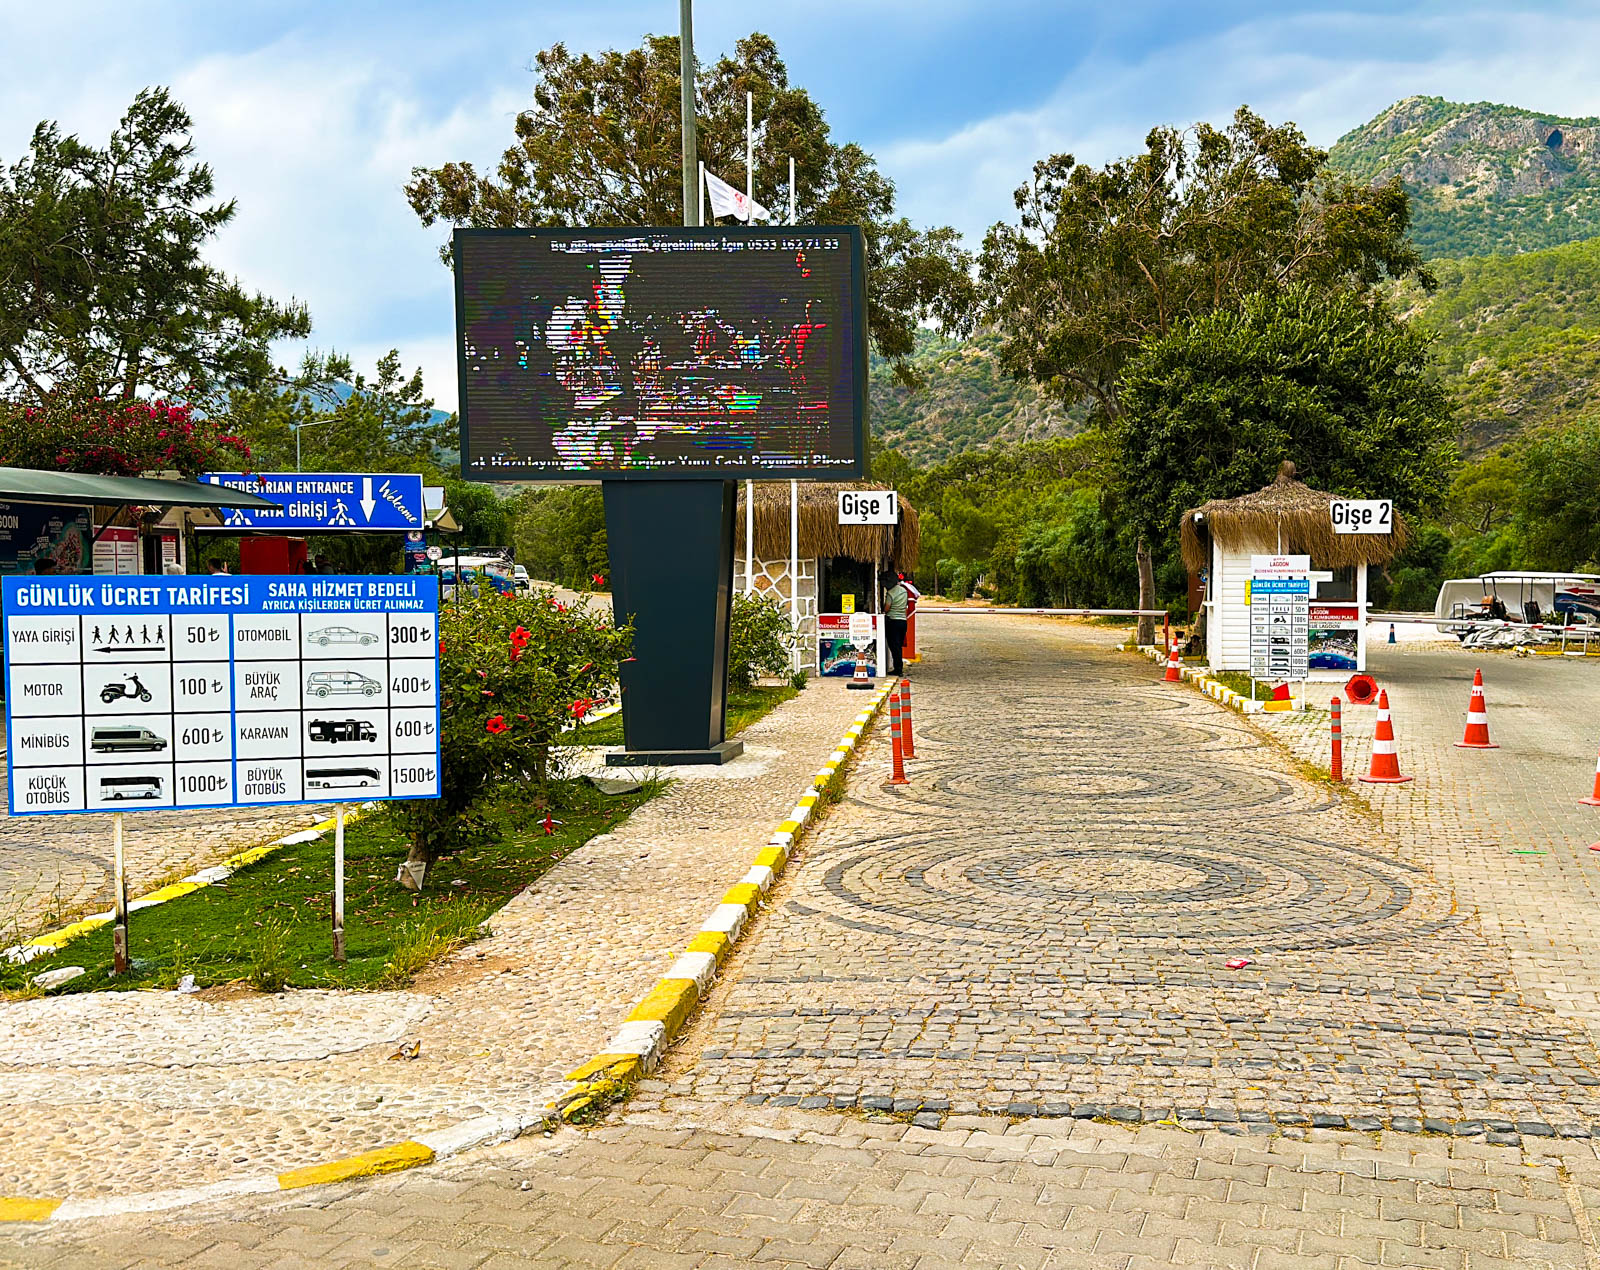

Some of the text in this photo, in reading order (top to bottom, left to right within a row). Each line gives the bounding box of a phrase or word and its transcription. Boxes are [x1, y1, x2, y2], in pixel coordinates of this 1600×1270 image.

[747, 239, 777, 250] 0533
[824, 239, 839, 250] 33
[296, 481, 354, 494] ENTRANCE
[378, 479, 418, 524] Welcome
[842, 493, 893, 521] Gişe 1
[288, 501, 328, 521] GİRİŞİ
[1332, 502, 1390, 531] Gişe 2
[17, 583, 249, 607] GÜNLÜK ÜCRET TARİFESİ
[268, 580, 416, 598] SAHA HİZMET BEDELİ
[262, 598, 424, 612] AYRICA KİŞİLERDEN ÜCRET ALINMAZ
[12, 628, 75, 645] YAYA GİRİŞİ
[237, 627, 292, 642] OTOMOBİL
[245, 672, 281, 685] BÜYÜK
[24, 683, 63, 696] MOTOR
[250, 686, 278, 701] ARAÇ
[240, 727, 289, 740] KARAVAN
[21, 735, 70, 748] MİNİBÜS
[247, 767, 283, 781] BÜYÜK
[28, 776, 67, 791] KÜÇÜK
[244, 782, 286, 796] OTOBÜS
[26, 790, 70, 805] OTOBÜS
